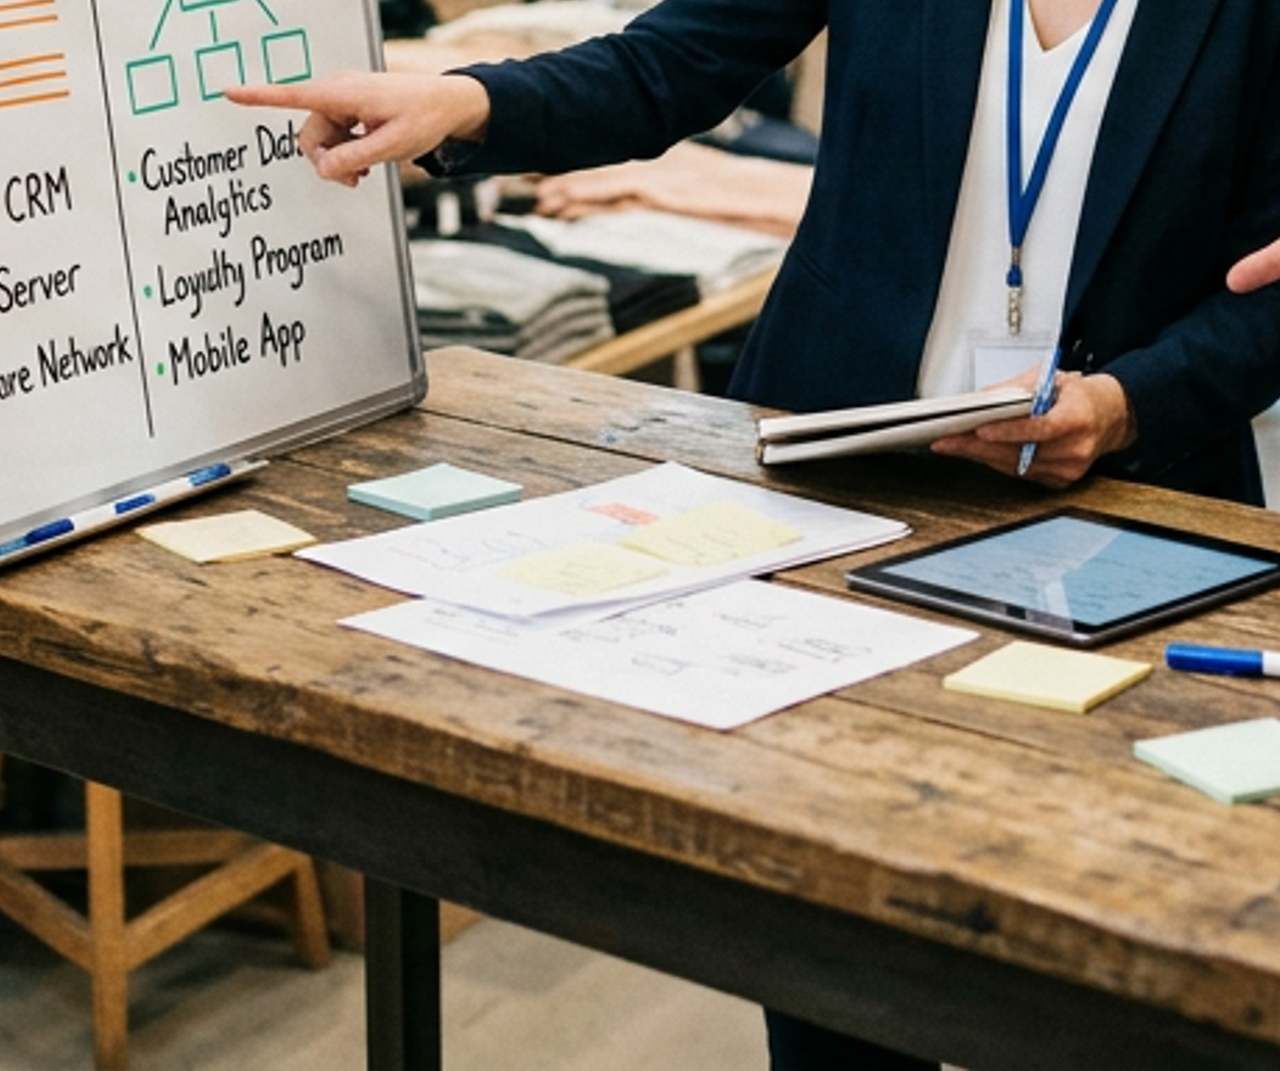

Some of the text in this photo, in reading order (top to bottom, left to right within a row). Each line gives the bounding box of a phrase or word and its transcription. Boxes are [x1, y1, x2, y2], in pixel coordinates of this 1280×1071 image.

[140, 119, 304, 192] Customer Dat
[4, 165, 73, 223] CRM
[250, 232, 345, 290] Program
[36, 323, 133, 388] Network
[168, 311, 306, 386] Mobile App
